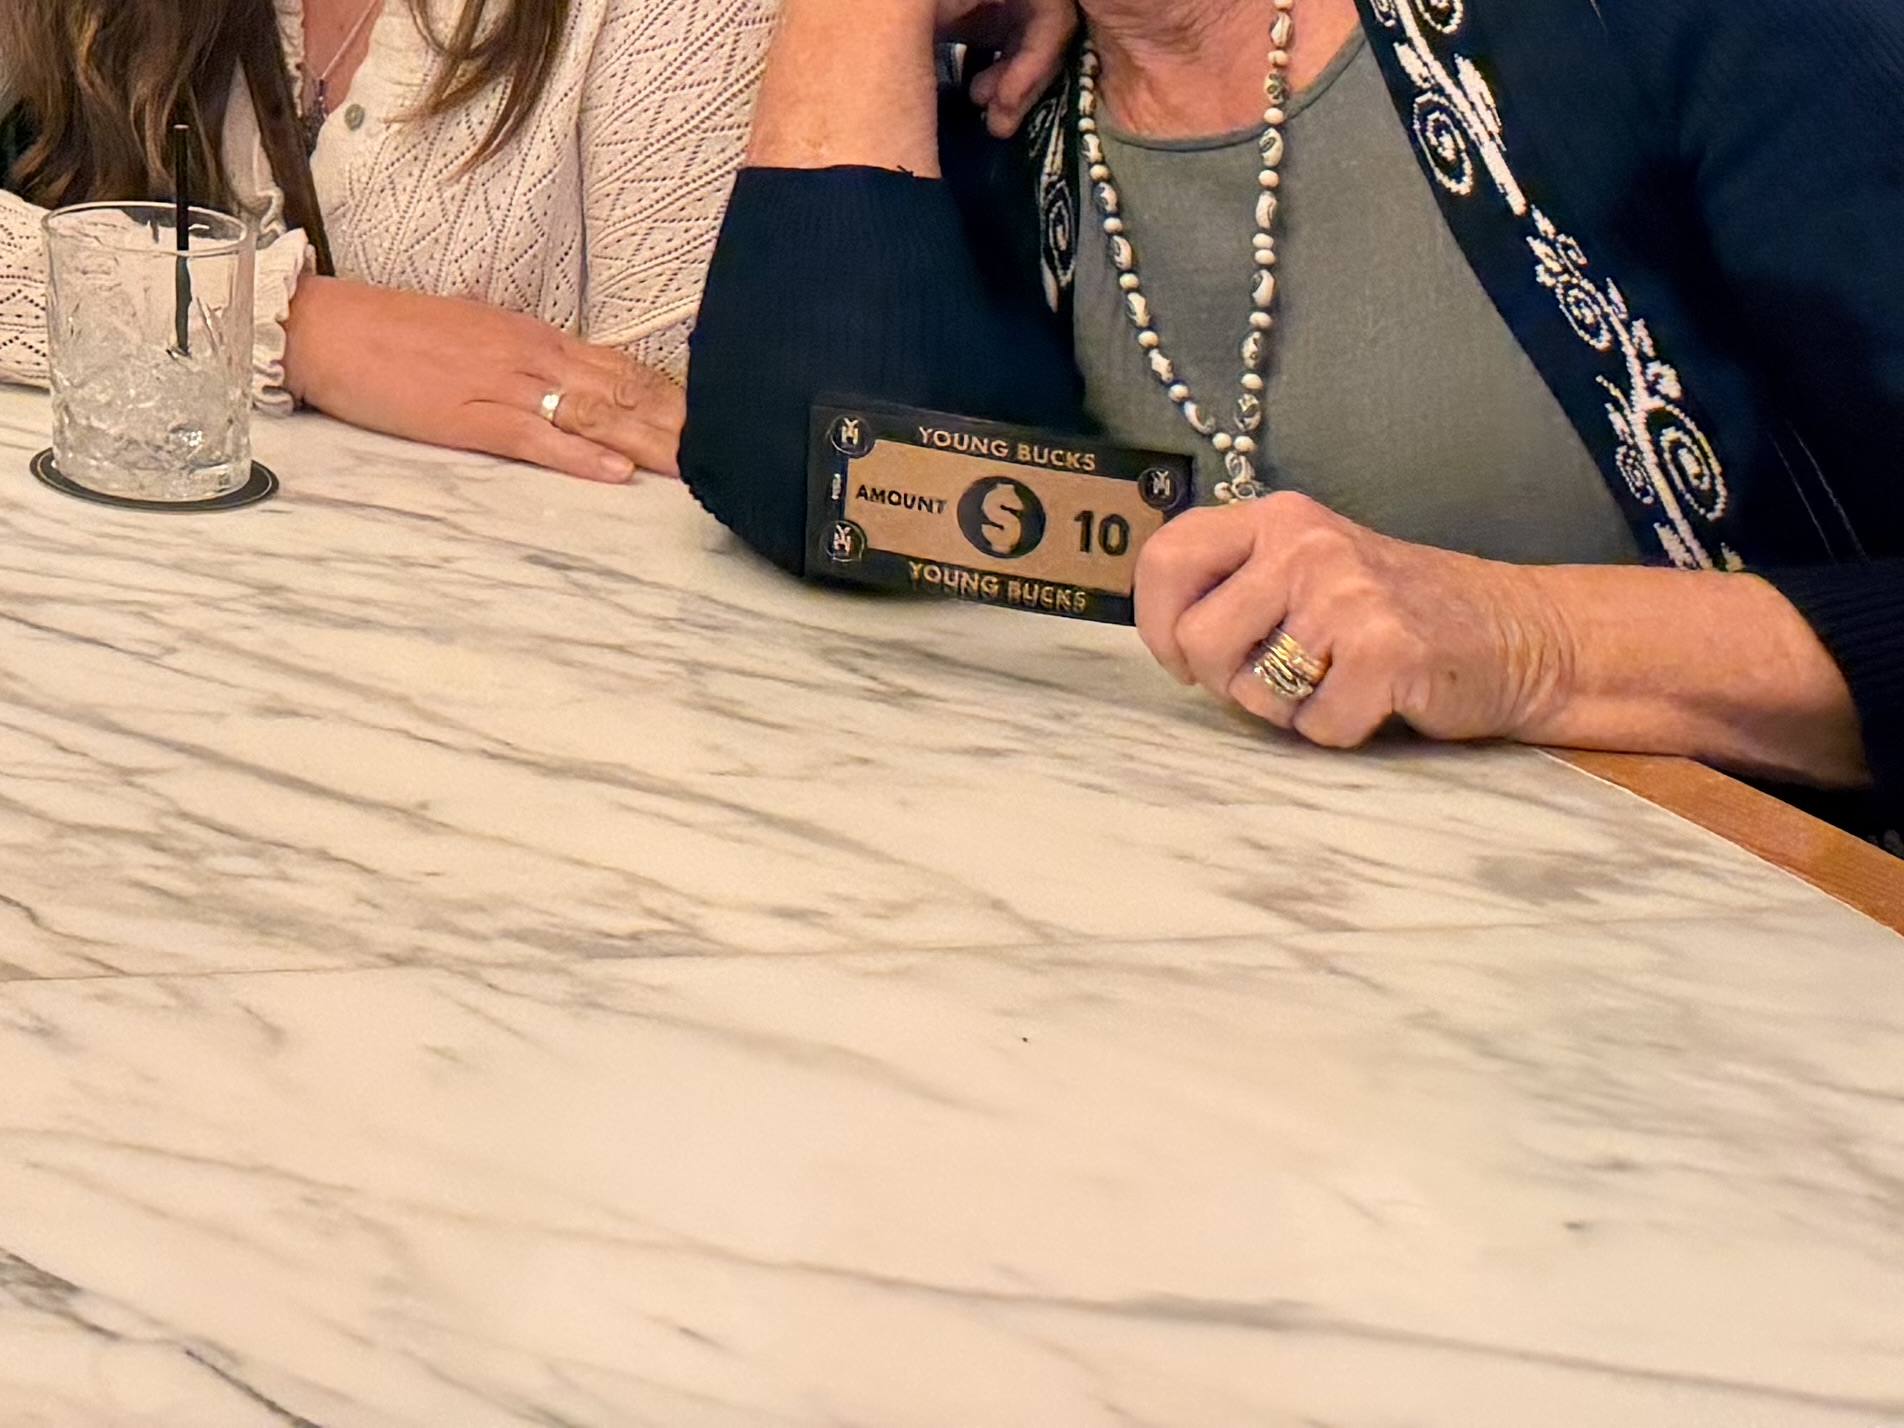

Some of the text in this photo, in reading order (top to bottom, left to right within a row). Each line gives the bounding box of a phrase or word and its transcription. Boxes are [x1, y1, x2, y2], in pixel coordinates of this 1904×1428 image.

[919, 425, 1097, 472] YOUNG BUCKS
[855, 483, 948, 515] AMOUNT
[1073, 508, 1132, 558] 10
[908, 559, 1088, 613] YOUNG BUCKS
